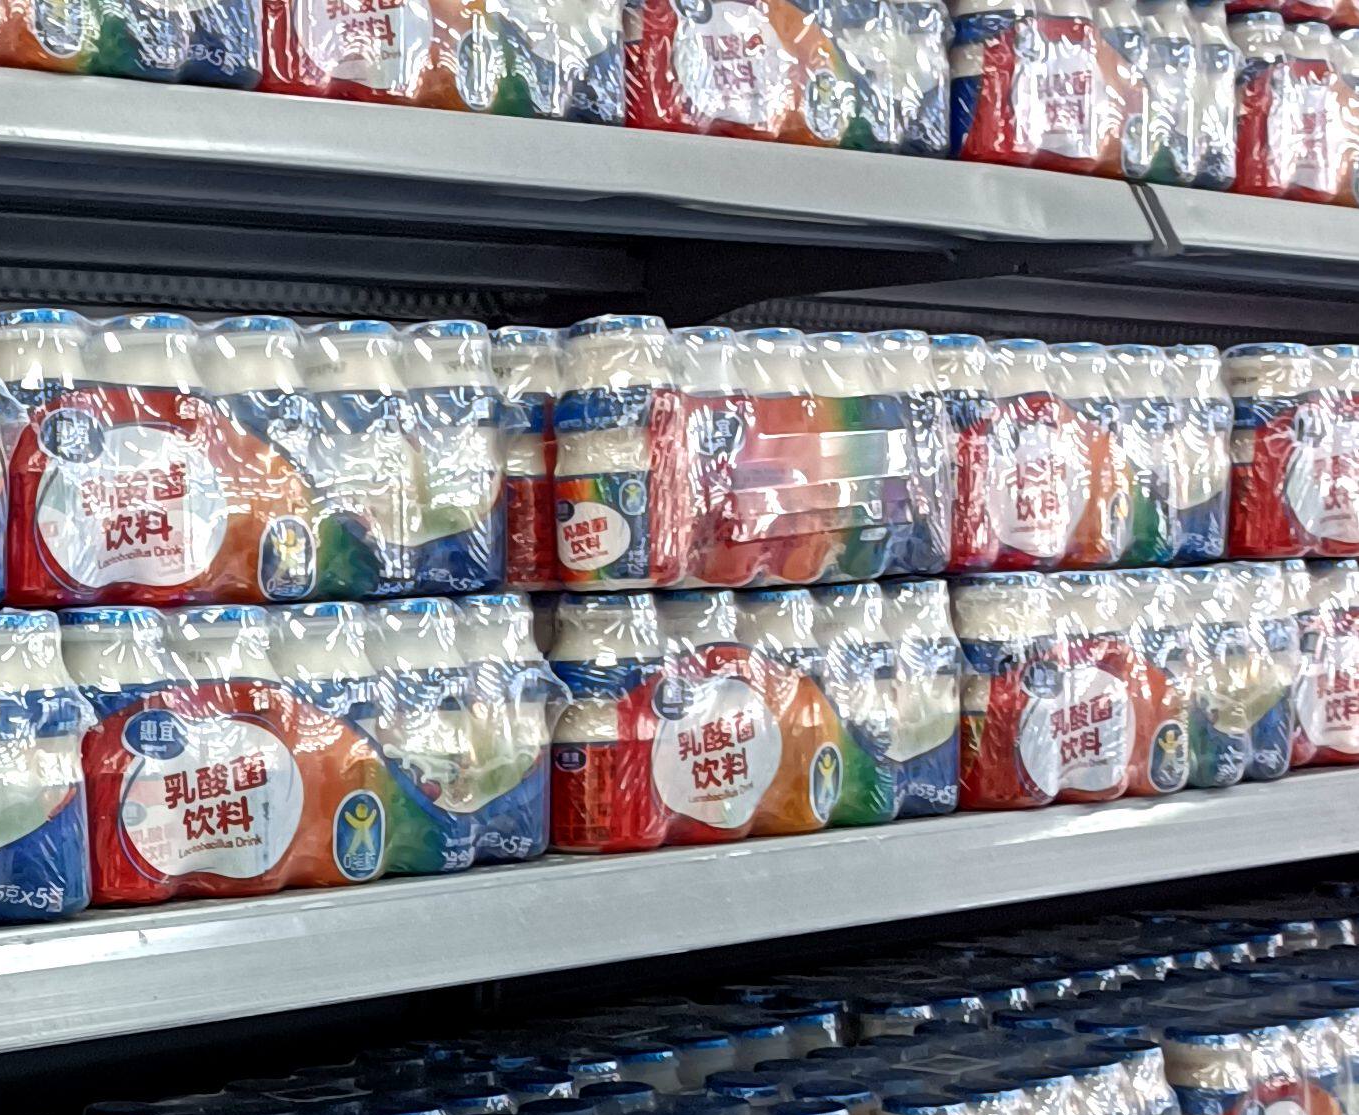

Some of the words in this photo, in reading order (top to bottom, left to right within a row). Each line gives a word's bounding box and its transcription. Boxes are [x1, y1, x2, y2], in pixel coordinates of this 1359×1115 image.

[104, 511, 174, 552] 饮料
[140, 719, 175, 743] 惠宜
[163, 752, 268, 810] 乳酸菌
[692, 751, 749, 791] 饮料
[183, 796, 255, 841] 饮料
